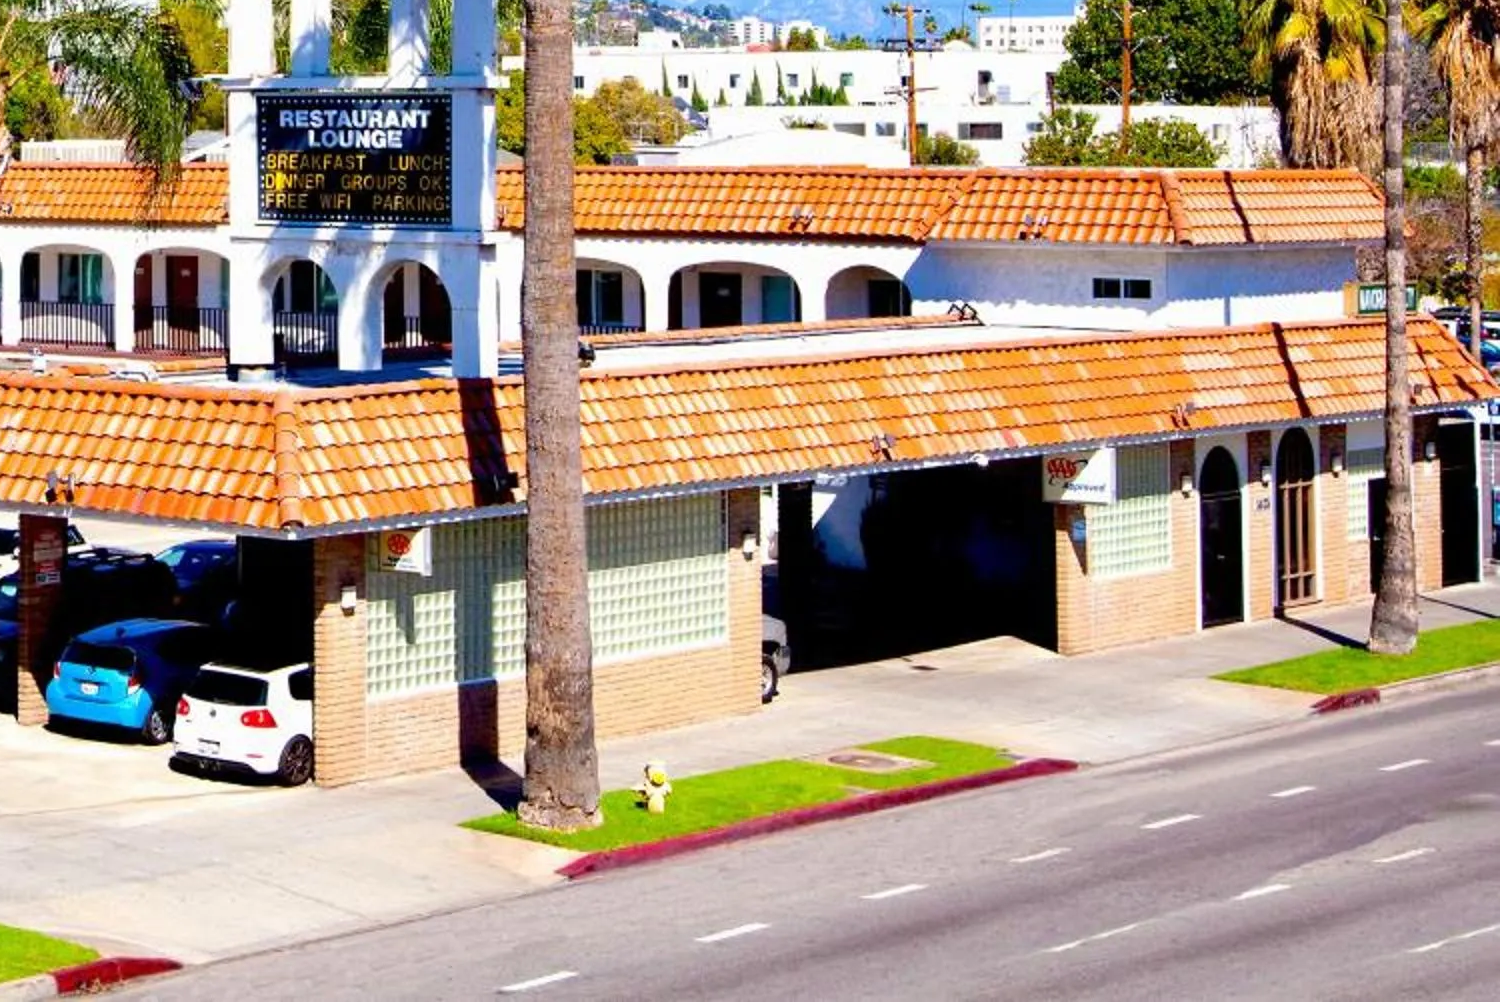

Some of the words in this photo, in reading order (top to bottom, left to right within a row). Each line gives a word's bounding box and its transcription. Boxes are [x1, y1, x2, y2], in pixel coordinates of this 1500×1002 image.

[279, 109, 431, 128] RESTAURANT
[307, 130, 403, 148] LOUNGE
[265, 154, 366, 171] BREAKFAST
[389, 154, 444, 171] LUNCH
[265, 172, 325, 191] DINNER
[341, 174, 408, 191] GROUPS
[419, 175, 443, 191] OK
[265, 193, 309, 209] FREE
[320, 193, 351, 209] WIFI
[372, 194, 445, 211] PARKING
